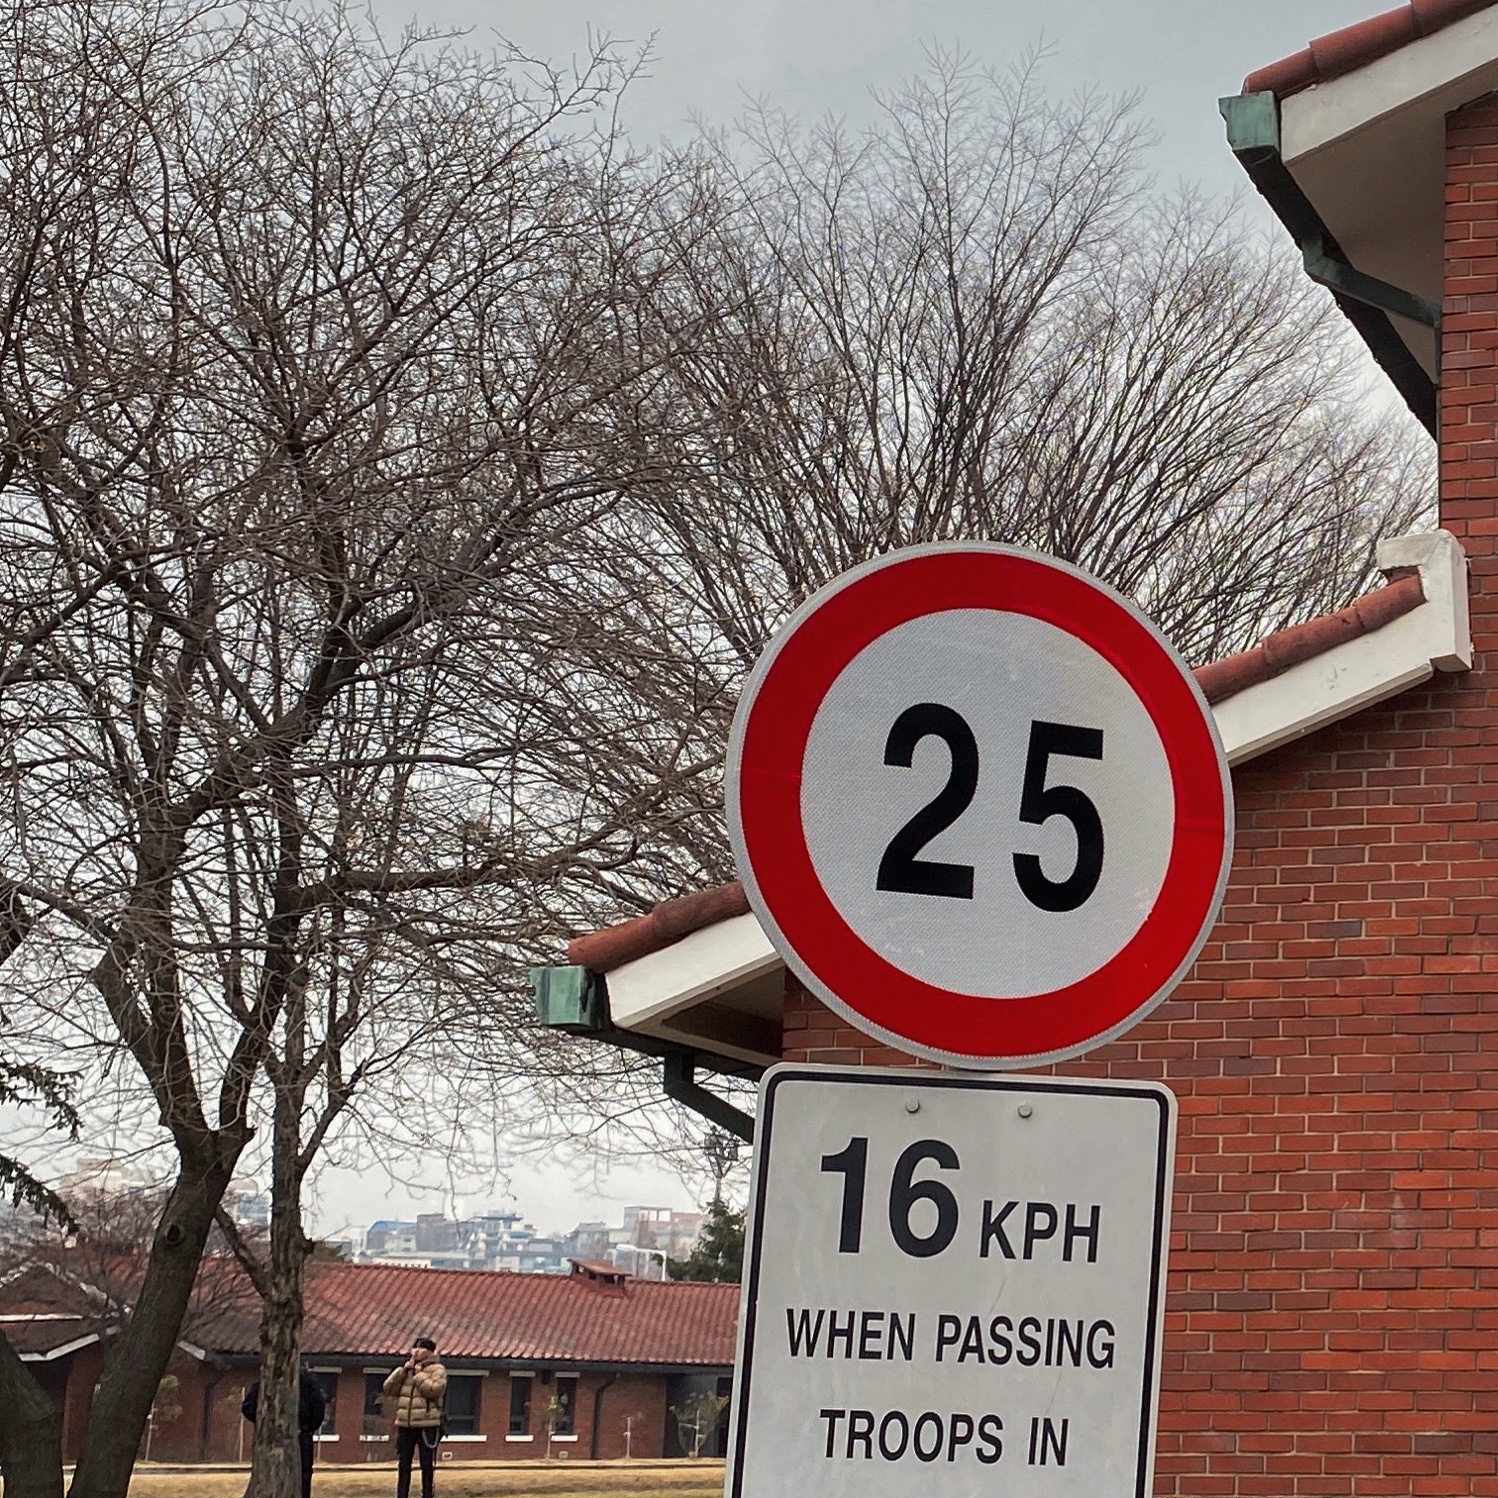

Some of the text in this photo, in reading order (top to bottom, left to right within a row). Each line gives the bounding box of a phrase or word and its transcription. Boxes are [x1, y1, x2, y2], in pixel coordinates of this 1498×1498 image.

[876, 702, 1104, 913] 25
[819, 1136, 1101, 1263] 16 KPH
[786, 1308, 1115, 1369] WHEN PASSING
[819, 1408, 1069, 1467] TROOPS IN
